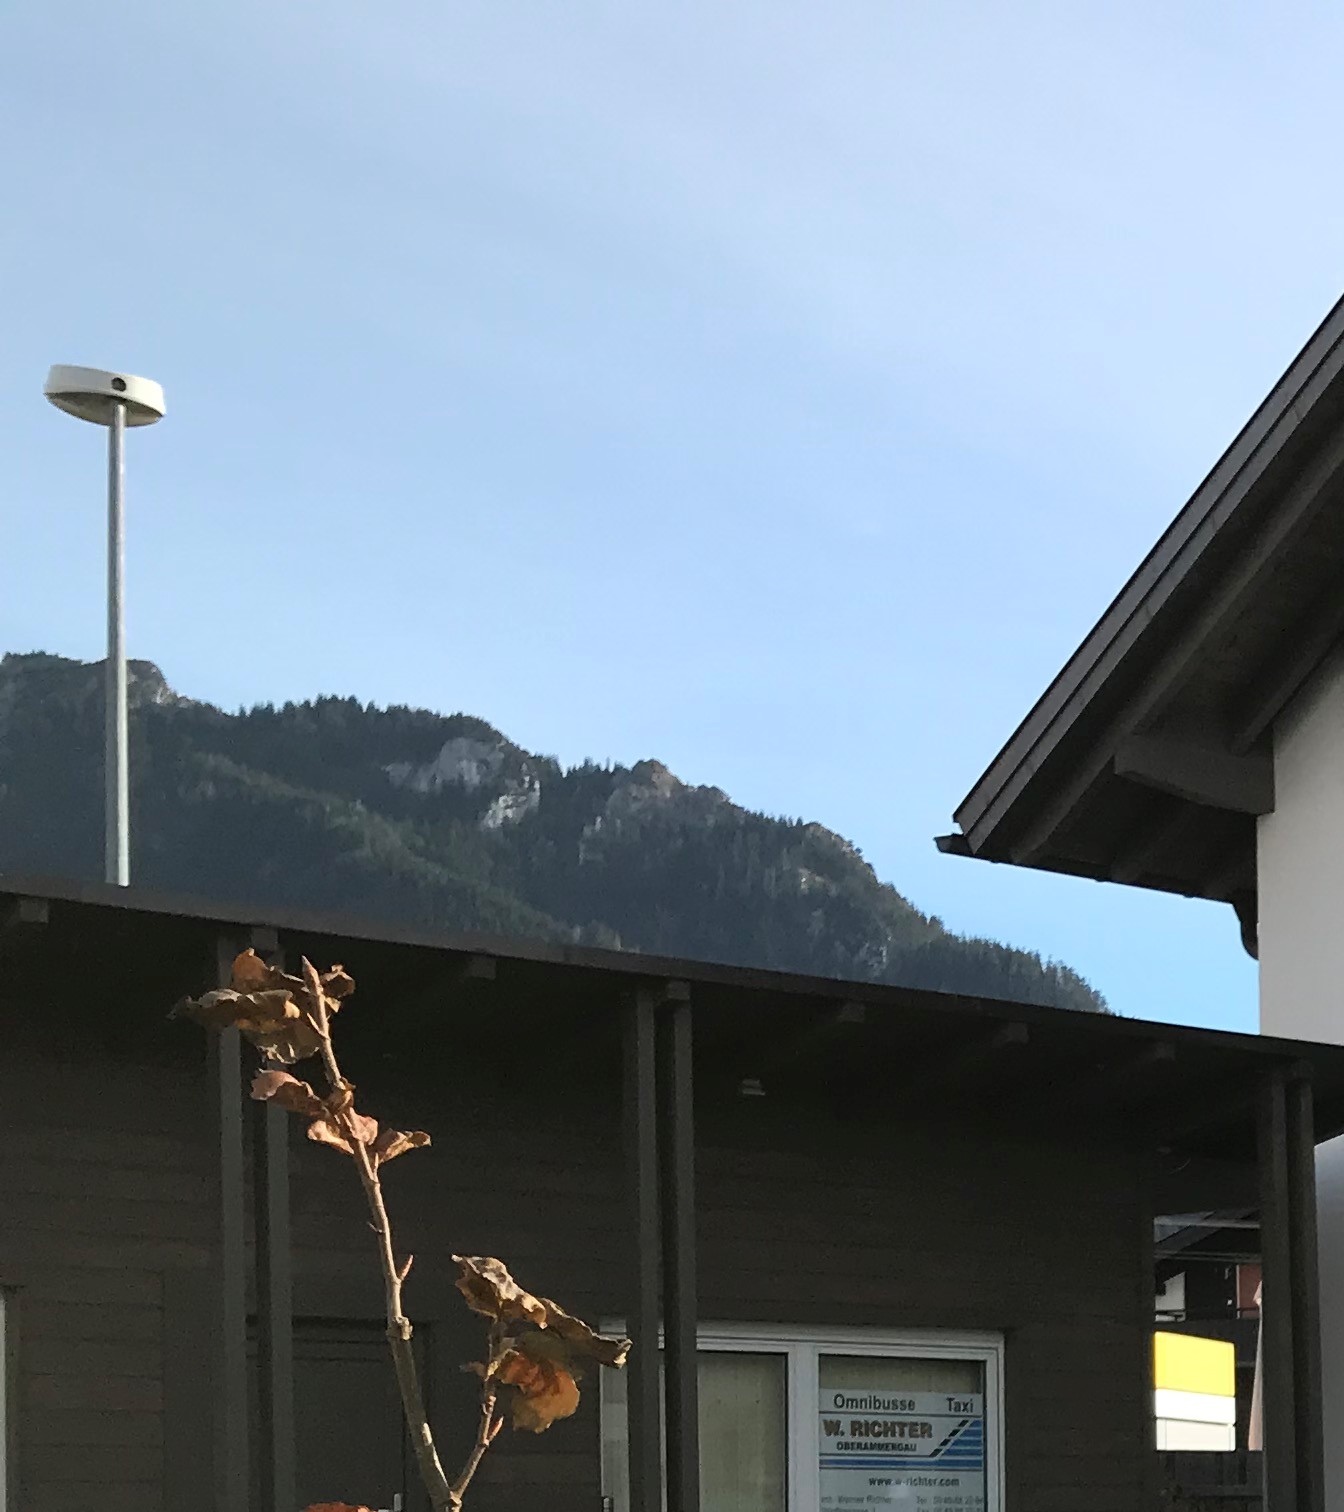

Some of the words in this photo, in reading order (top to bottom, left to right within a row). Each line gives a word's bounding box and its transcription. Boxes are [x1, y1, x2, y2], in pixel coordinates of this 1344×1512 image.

[833, 1393, 916, 1412] Omnibusse
[945, 1397, 975, 1413] Taxi
[822, 1418, 845, 1438] W.
[849, 1419, 934, 1440] RICHTER
[836, 1441, 917, 1452] OBERAMMERGAU
